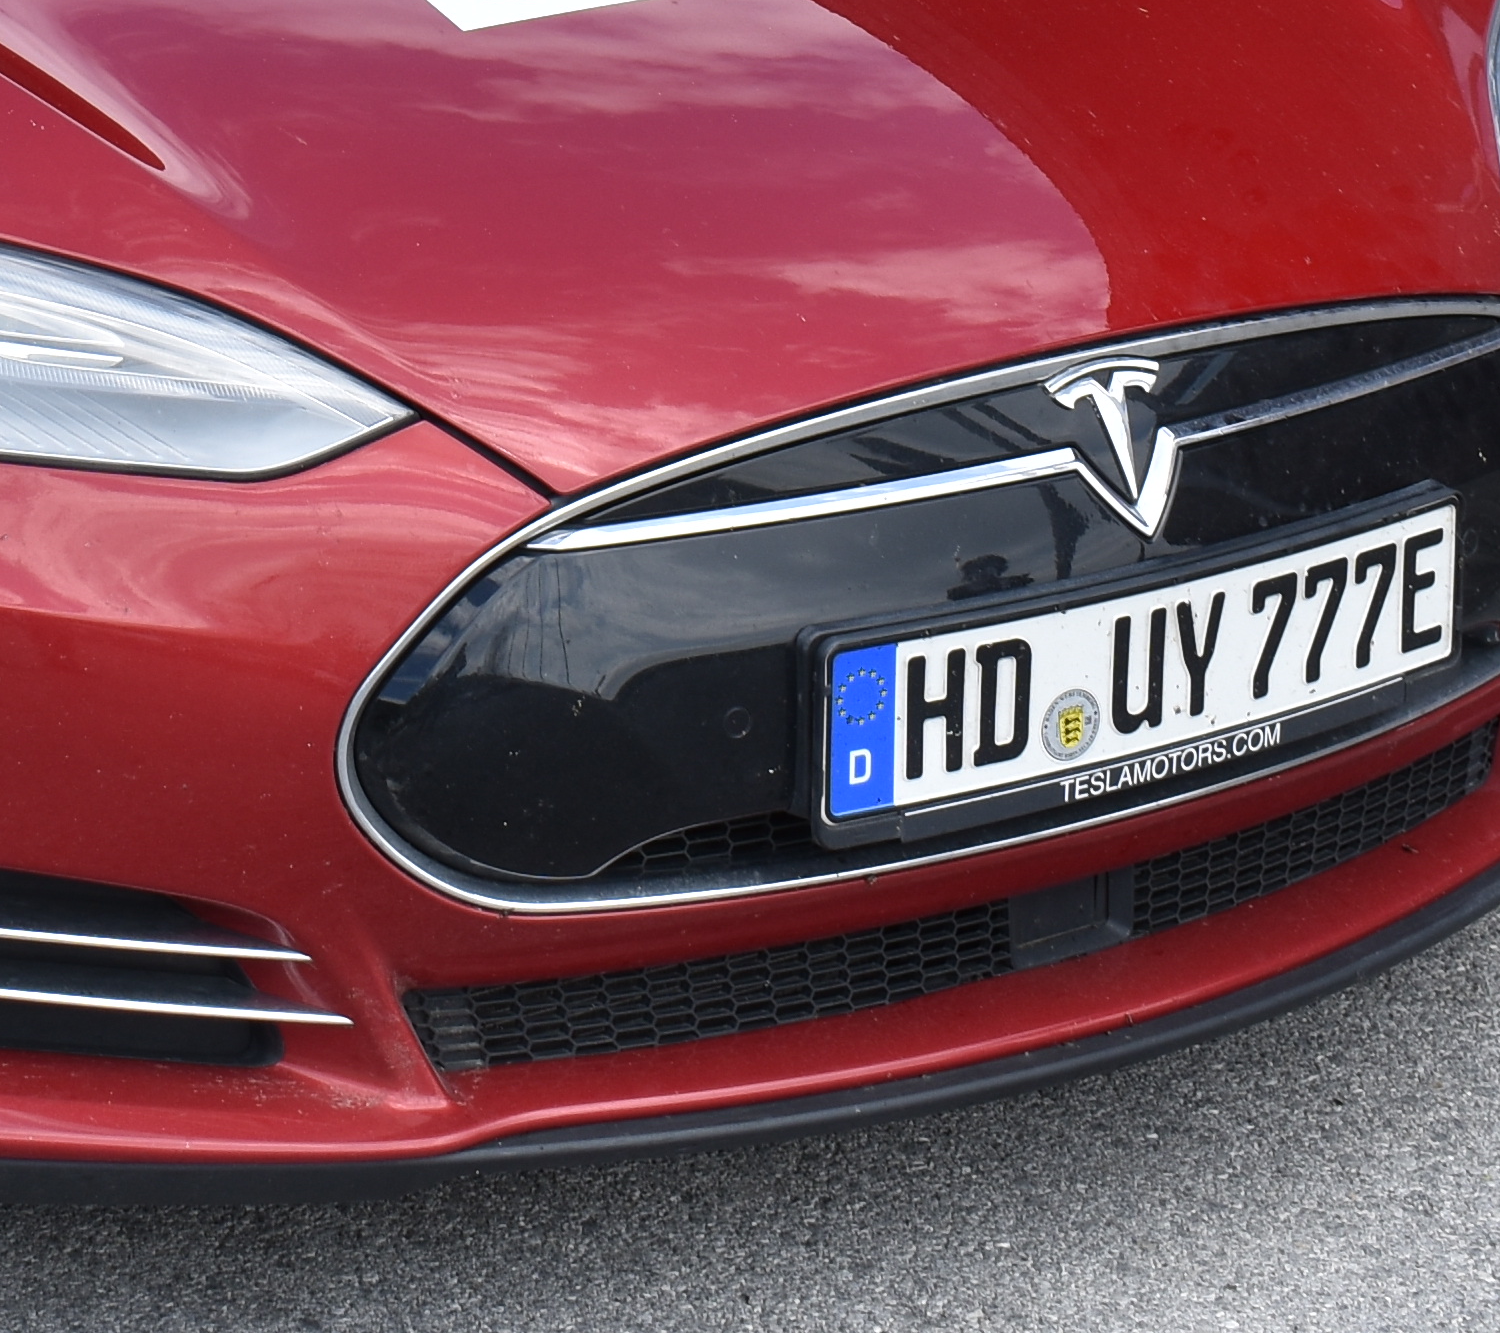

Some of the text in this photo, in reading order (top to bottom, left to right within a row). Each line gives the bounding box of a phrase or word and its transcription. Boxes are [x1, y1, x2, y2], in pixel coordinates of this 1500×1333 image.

[848, 747, 872, 786] D
[905, 637, 1034, 782] HD
[1110, 589, 1227, 735] UY
[1250, 527, 1445, 699] 777E
[1059, 722, 1282, 804] TESLAMOTORS.COM
